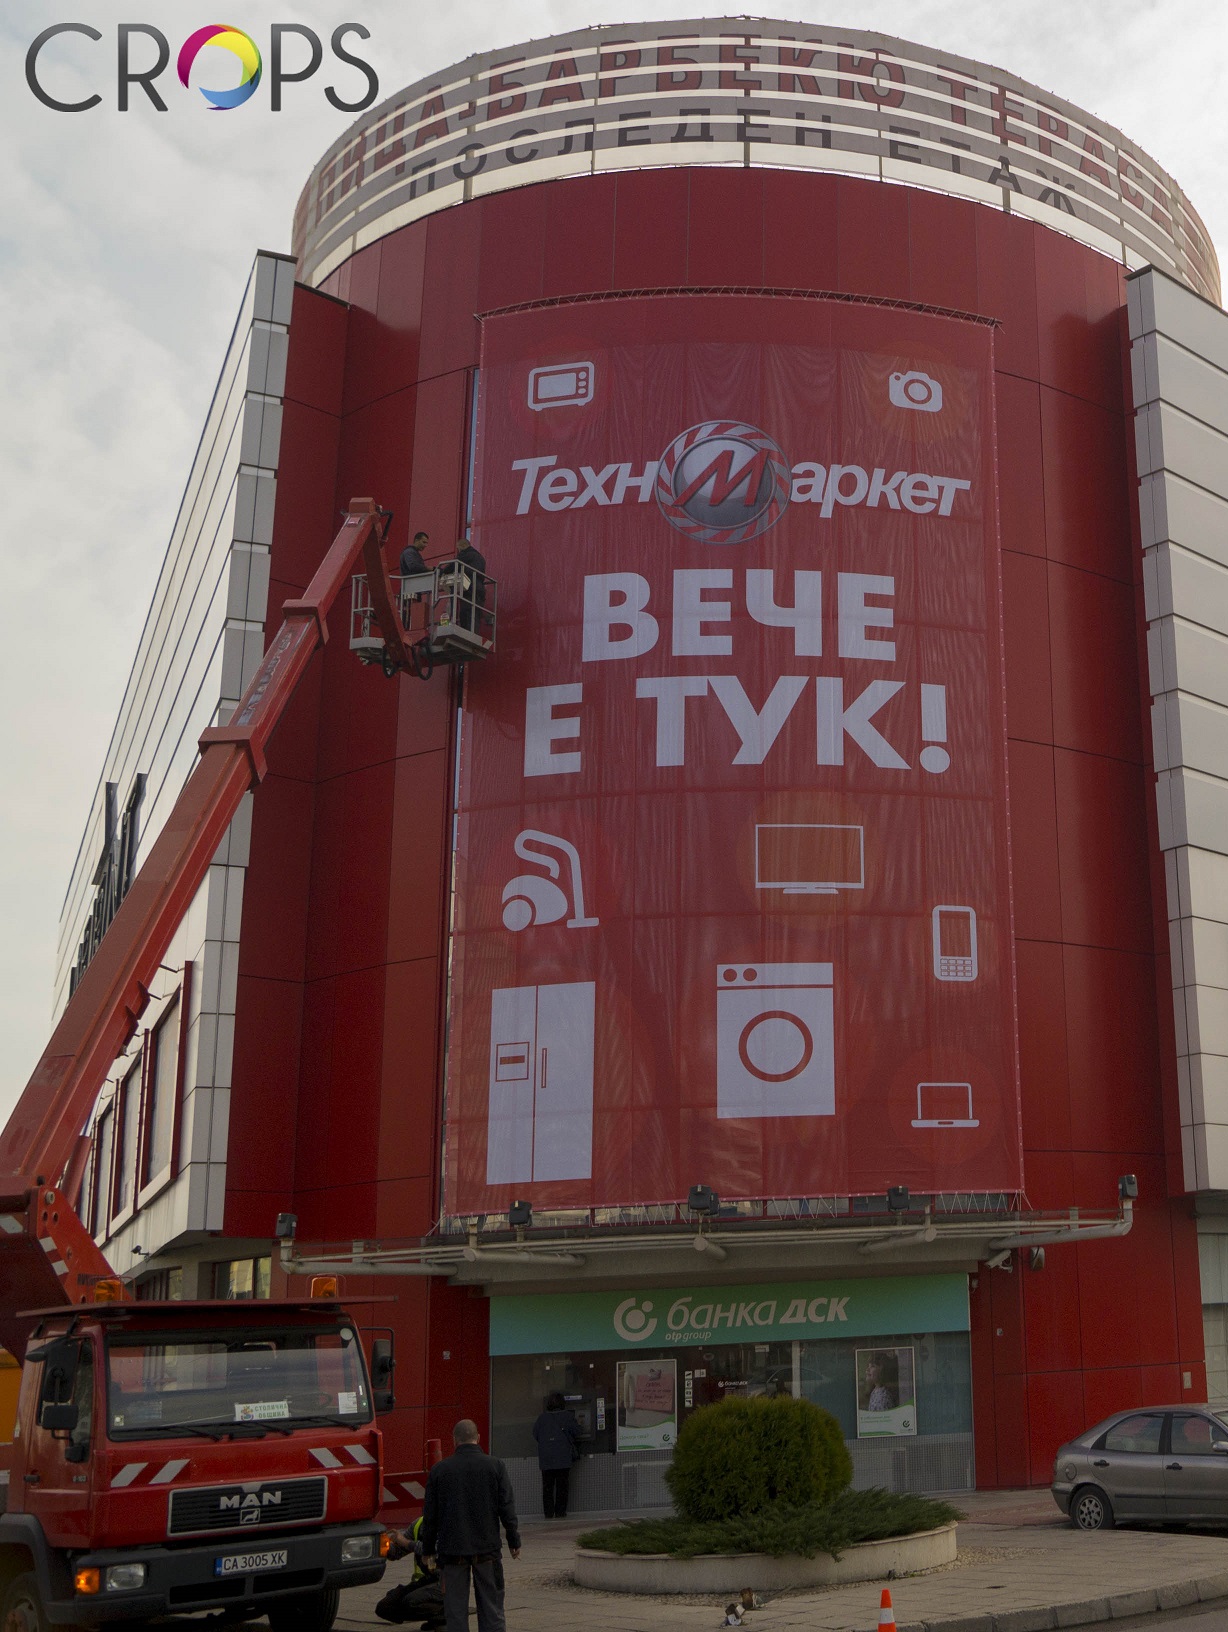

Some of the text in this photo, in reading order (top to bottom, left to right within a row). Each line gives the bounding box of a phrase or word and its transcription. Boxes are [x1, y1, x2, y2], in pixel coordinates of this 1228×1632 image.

[581, 568, 896, 662] ВЕЧЕ
[524, 675, 950, 777] Е ТУК!
[666, 1296, 851, 1330] банка ДСК
[254, 1402, 288, 1412] СТОЛИЧНА
[258, 1411, 286, 1419] ОБЩИНА
[219, 1491, 282, 1510] MAN
[223, 1551, 285, 1571] CA 3005 XK
